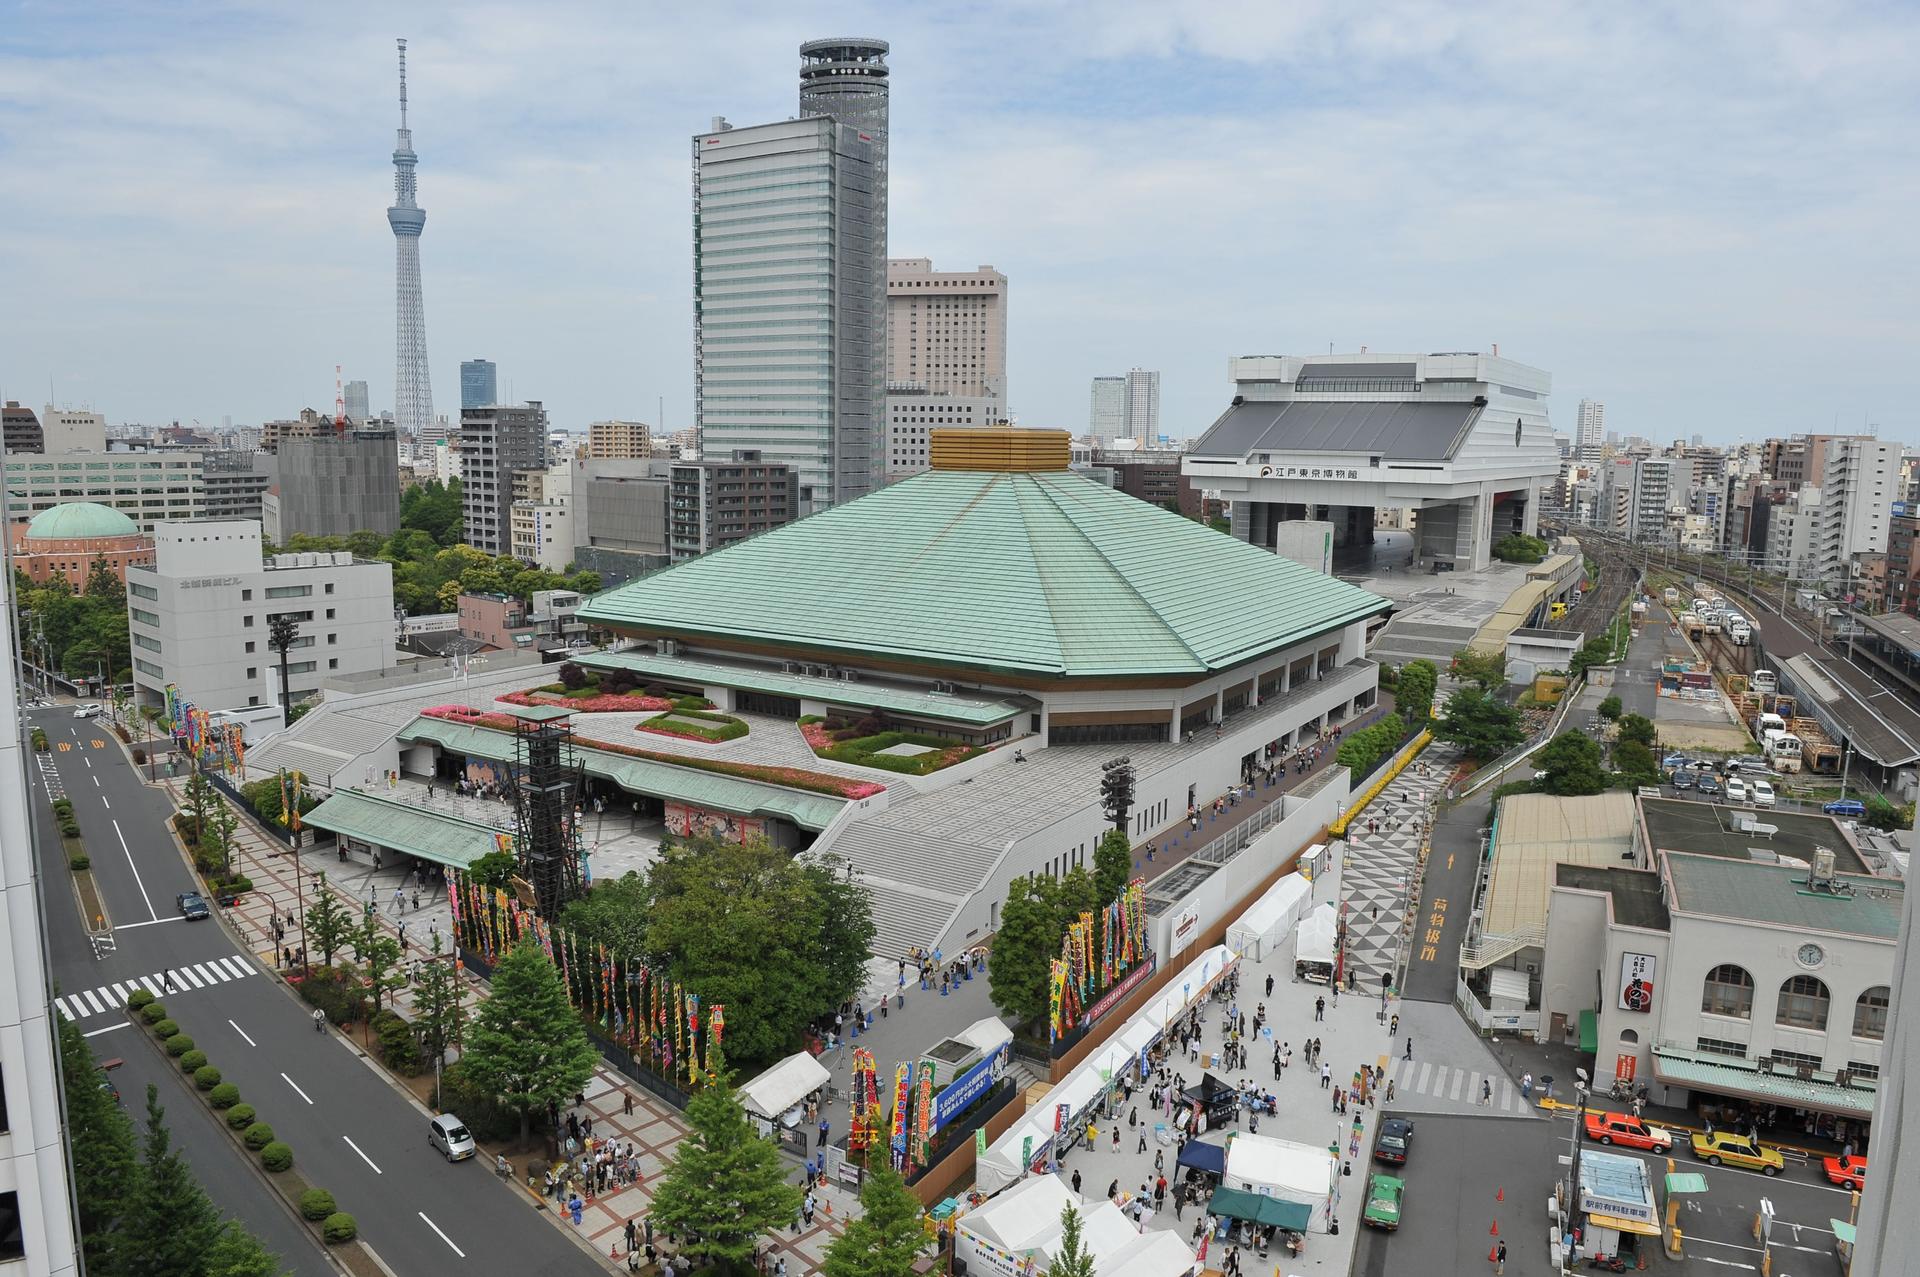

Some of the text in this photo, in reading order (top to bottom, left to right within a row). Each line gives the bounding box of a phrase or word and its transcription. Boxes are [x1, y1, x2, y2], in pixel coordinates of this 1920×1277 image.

[1275, 466, 1358, 480] 江戸東京博物館
[1630, 978, 1643, 1011] 花の舞
[1585, 1199, 1648, 1219] 駅前有料駐車場
